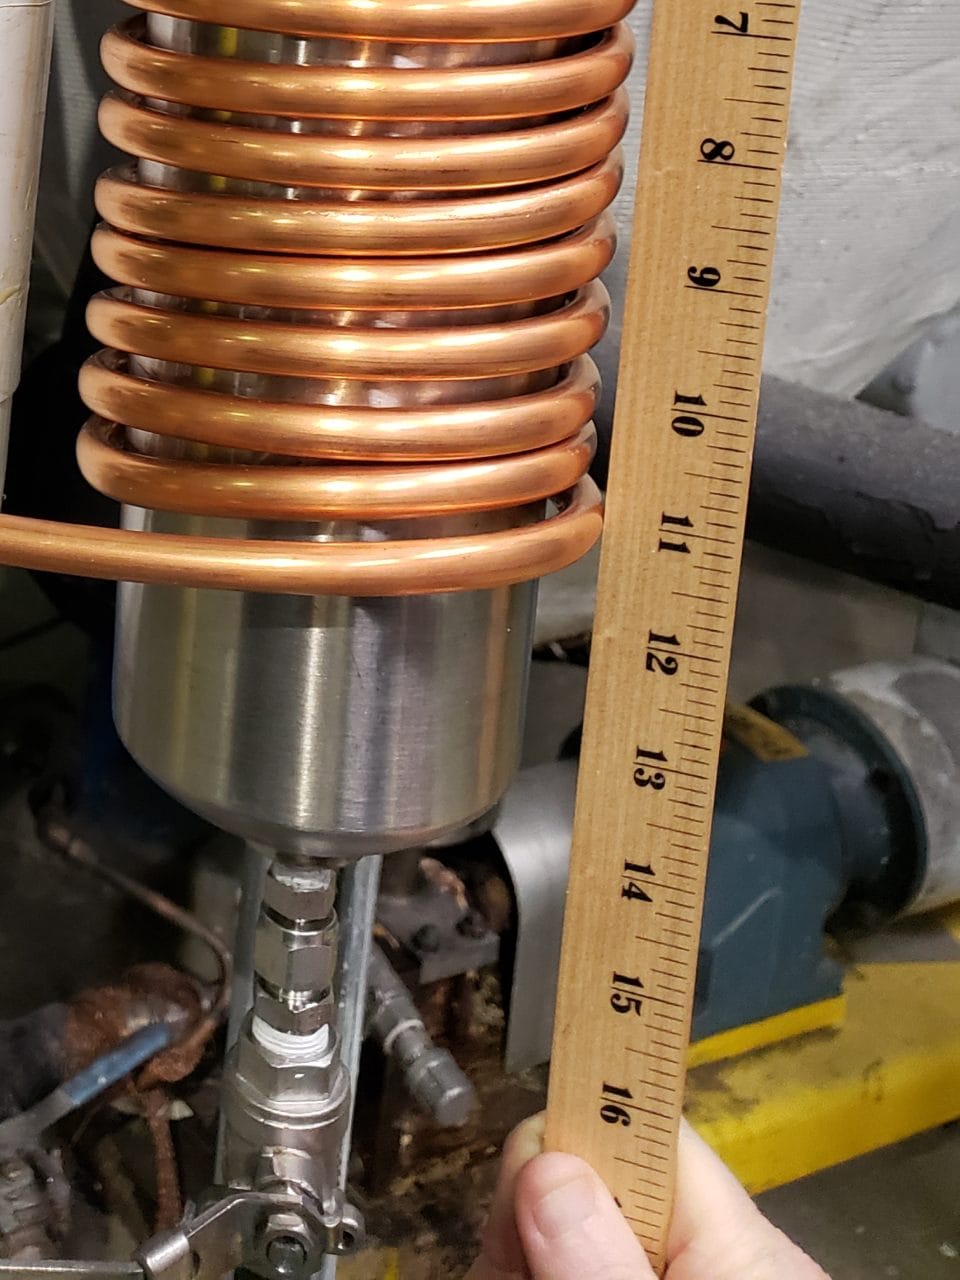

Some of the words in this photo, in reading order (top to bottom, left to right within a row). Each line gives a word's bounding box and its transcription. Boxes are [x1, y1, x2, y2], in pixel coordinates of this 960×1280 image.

[714, 11, 749, 33] 7
[700, 137, 735, 161] 8
[687, 265, 722, 288] 9
[671, 390, 708, 438] 10
[657, 510, 694, 555] 11
[645, 628, 681, 676] 12
[633, 745, 669, 791] 13
[621, 858, 657, 903] 14
[610, 970, 645, 1017] 15
[600, 1080, 634, 1128] 16
